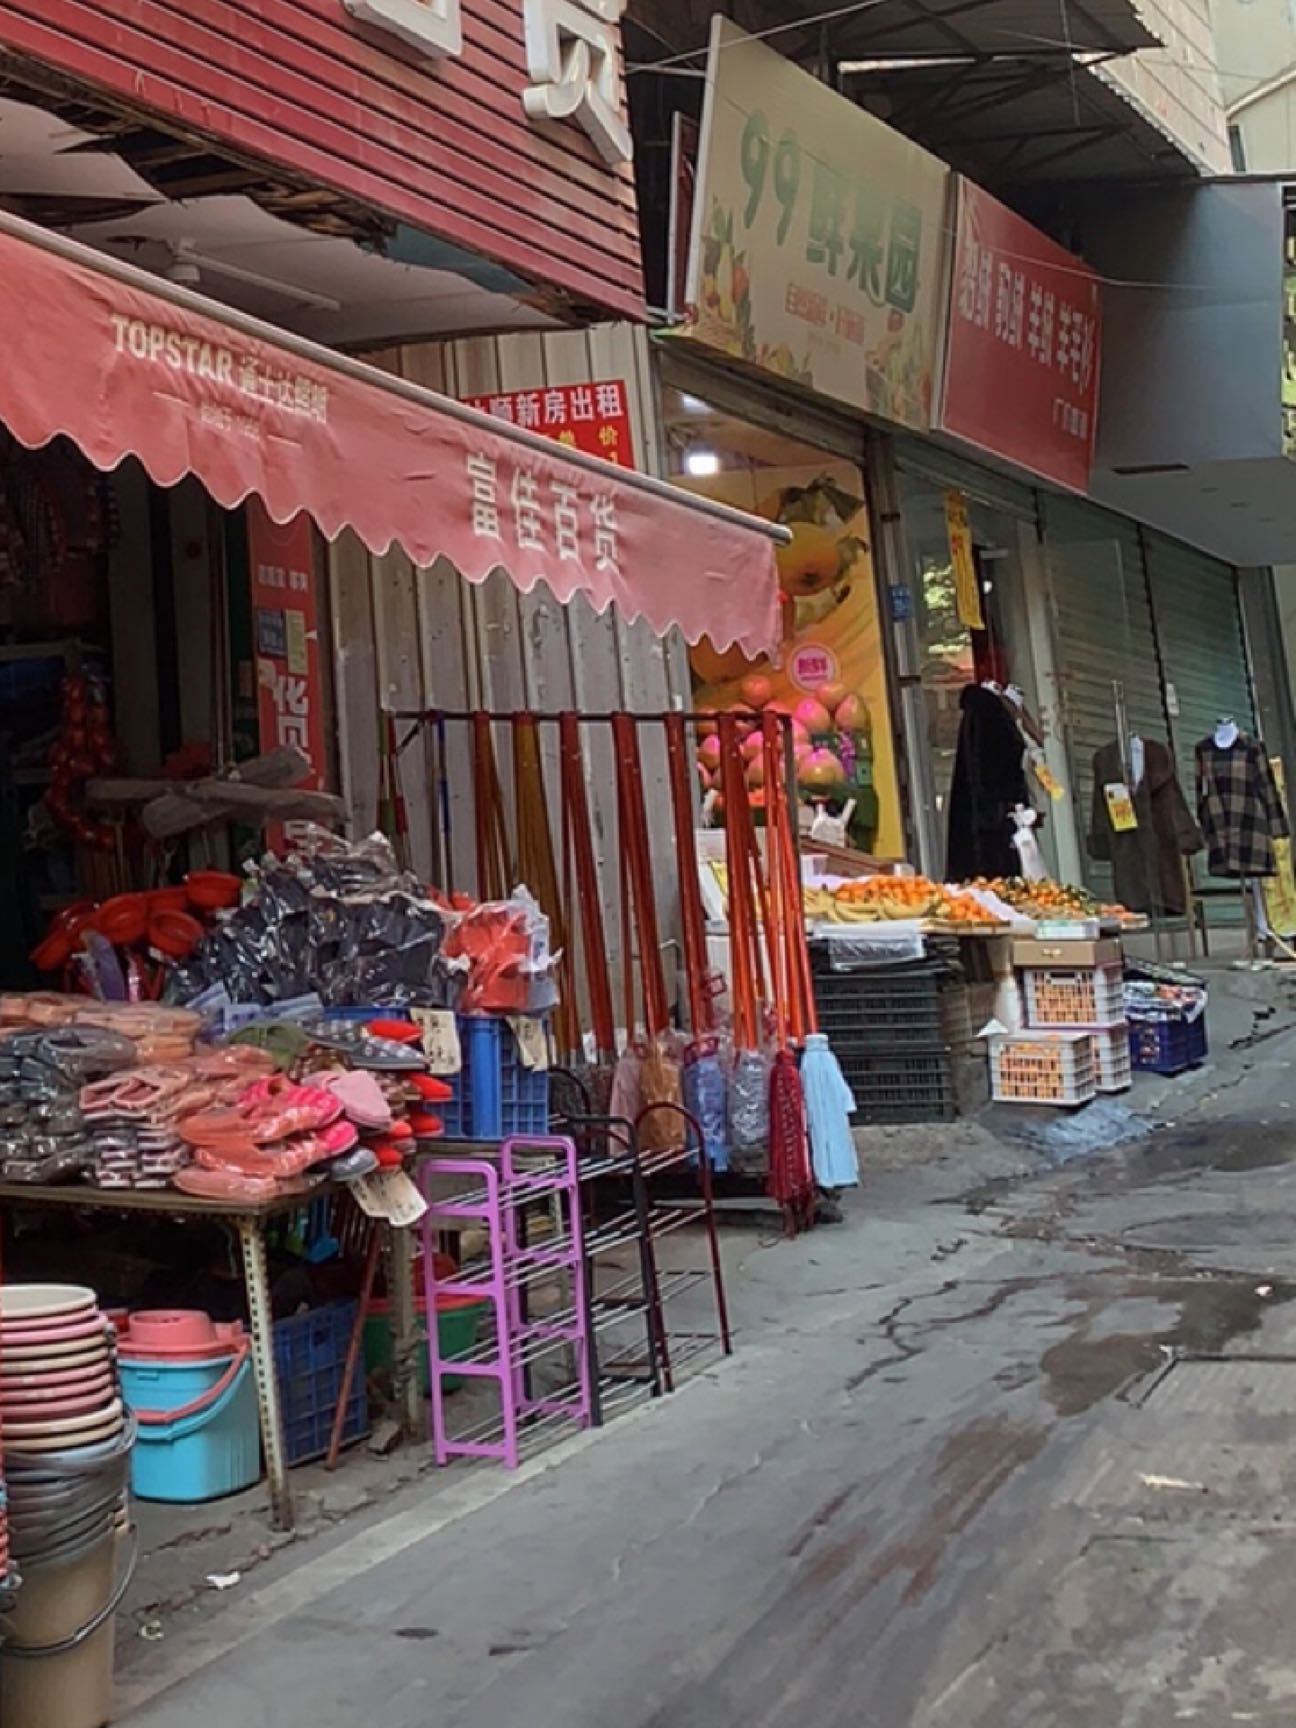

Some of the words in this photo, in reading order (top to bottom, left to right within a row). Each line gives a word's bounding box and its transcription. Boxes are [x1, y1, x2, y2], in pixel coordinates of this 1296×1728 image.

[110, 313, 233, 385] TOPSTAR
[468, 452, 620, 571] 富佳百货
